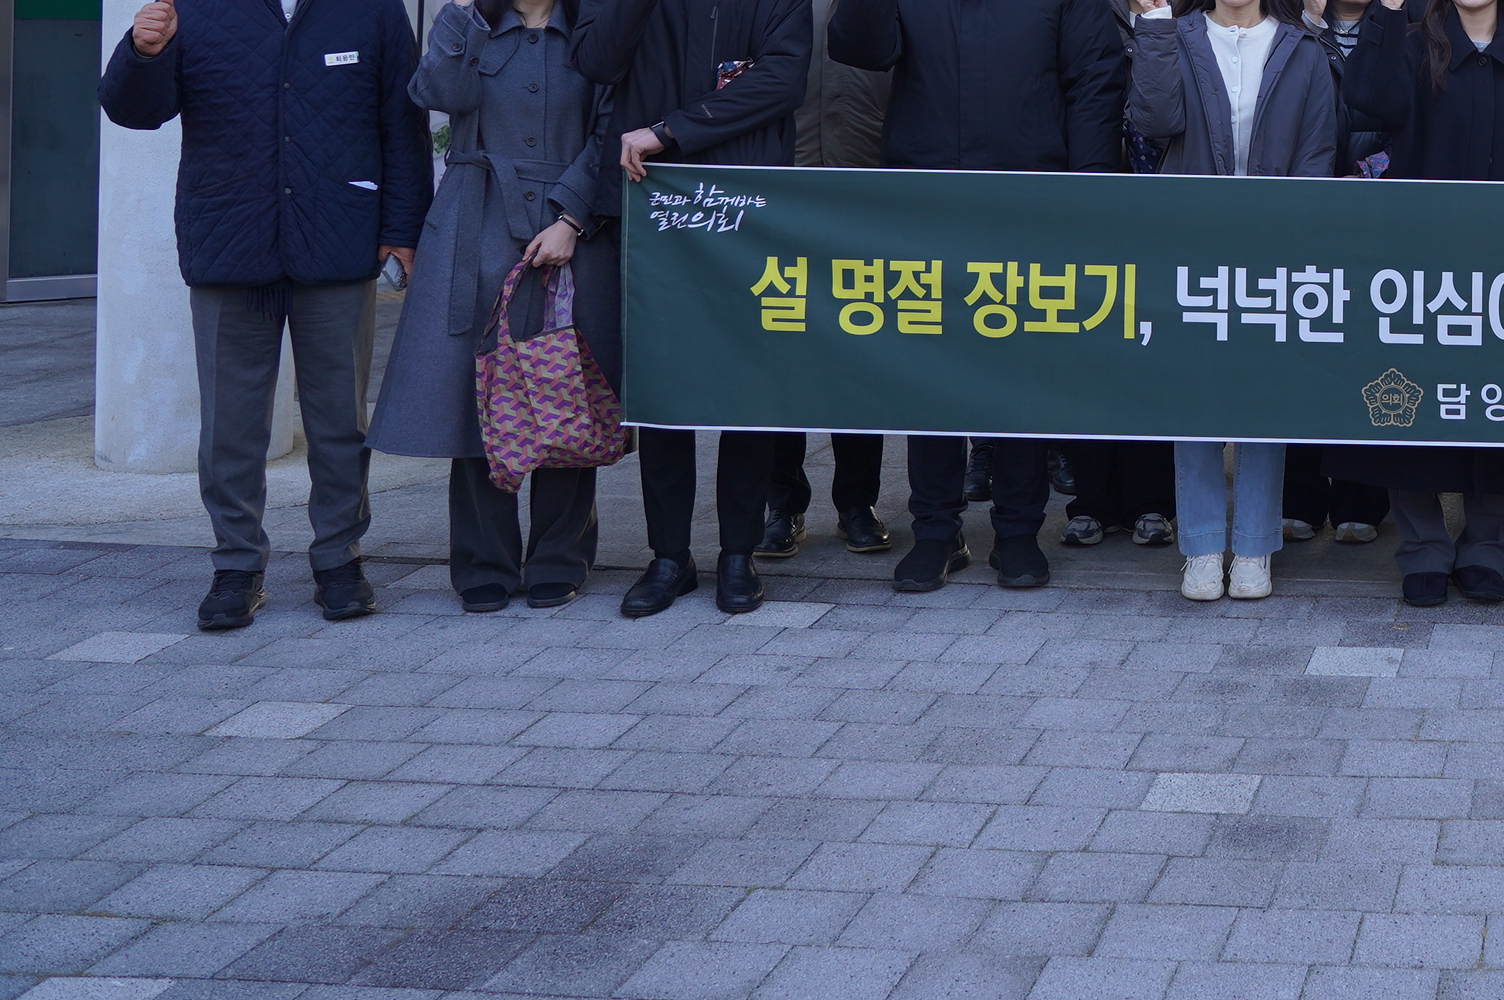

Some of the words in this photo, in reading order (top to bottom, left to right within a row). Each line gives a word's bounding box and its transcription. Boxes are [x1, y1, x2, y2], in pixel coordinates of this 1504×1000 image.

[749, 256, 808, 332] 설
[831, 258, 943, 336] 명절
[963, 261, 1153, 347] 장보기,
[1176, 264, 1351, 344] 넉넉한
[1381, 393, 1403, 406] 의회
